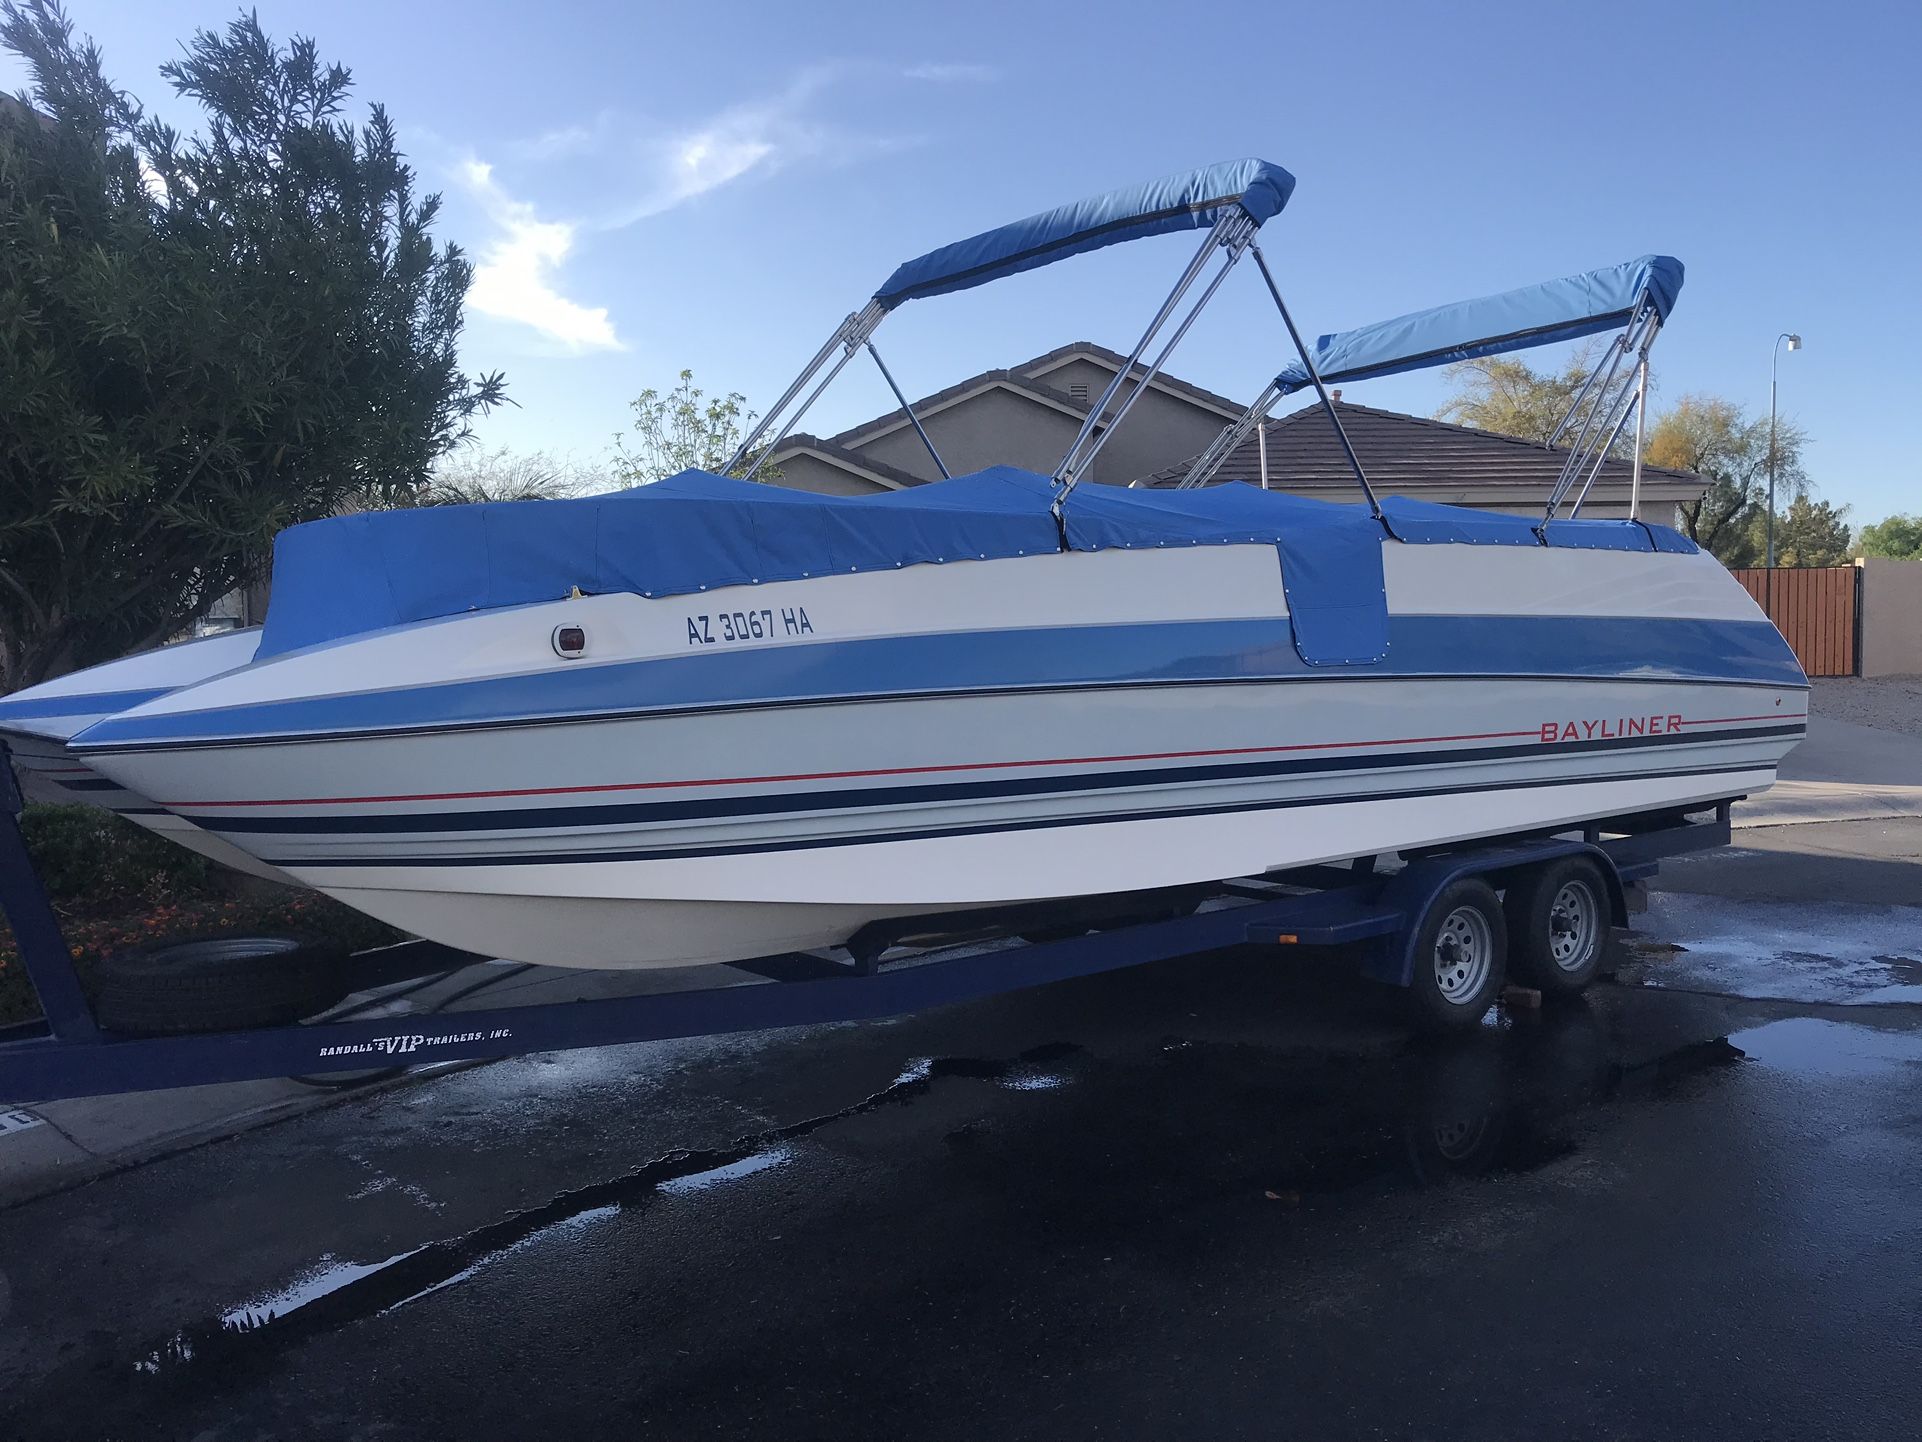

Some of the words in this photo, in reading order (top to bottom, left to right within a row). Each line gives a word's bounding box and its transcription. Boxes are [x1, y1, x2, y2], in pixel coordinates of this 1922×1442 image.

[687, 616, 715, 645] AZ
[718, 609, 774, 641] 3067
[781, 606, 814, 635] HA
[1540, 714, 1682, 742] BAYLINER
[374, 1034, 425, 1054] VIP
[490, 1028, 513, 1039] INC.
